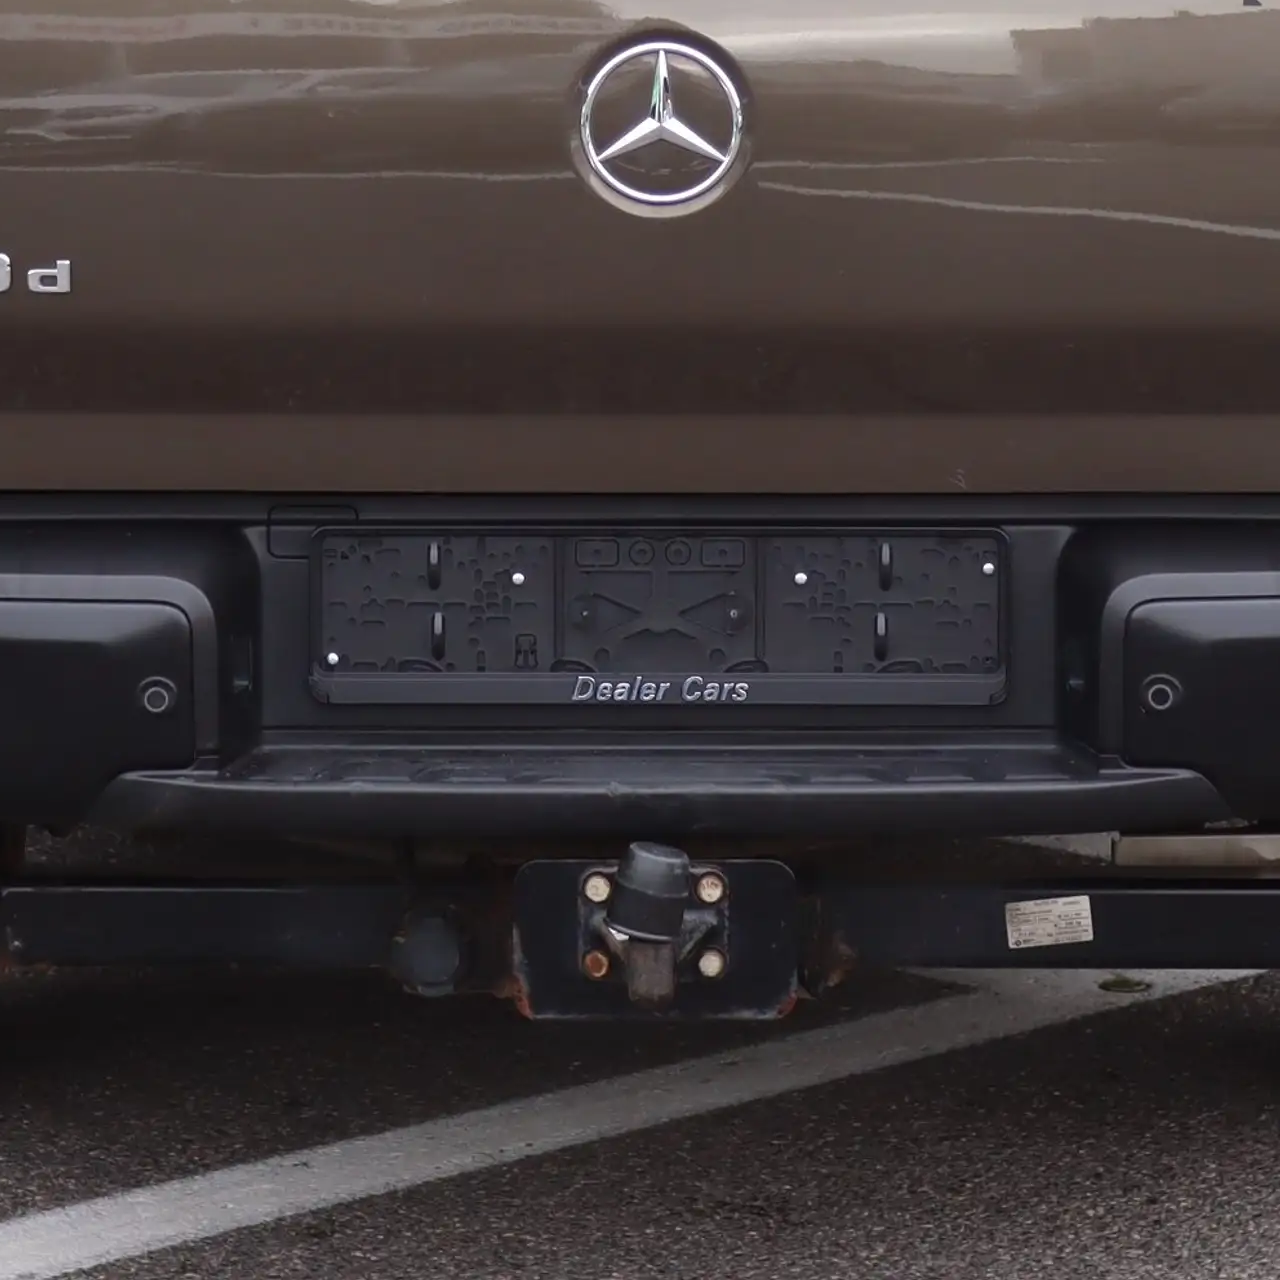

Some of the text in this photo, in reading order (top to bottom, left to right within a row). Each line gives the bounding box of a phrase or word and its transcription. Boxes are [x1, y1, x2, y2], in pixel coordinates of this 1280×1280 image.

[27, 259, 71, 293] d
[572, 675, 750, 701] Dealer Cars
